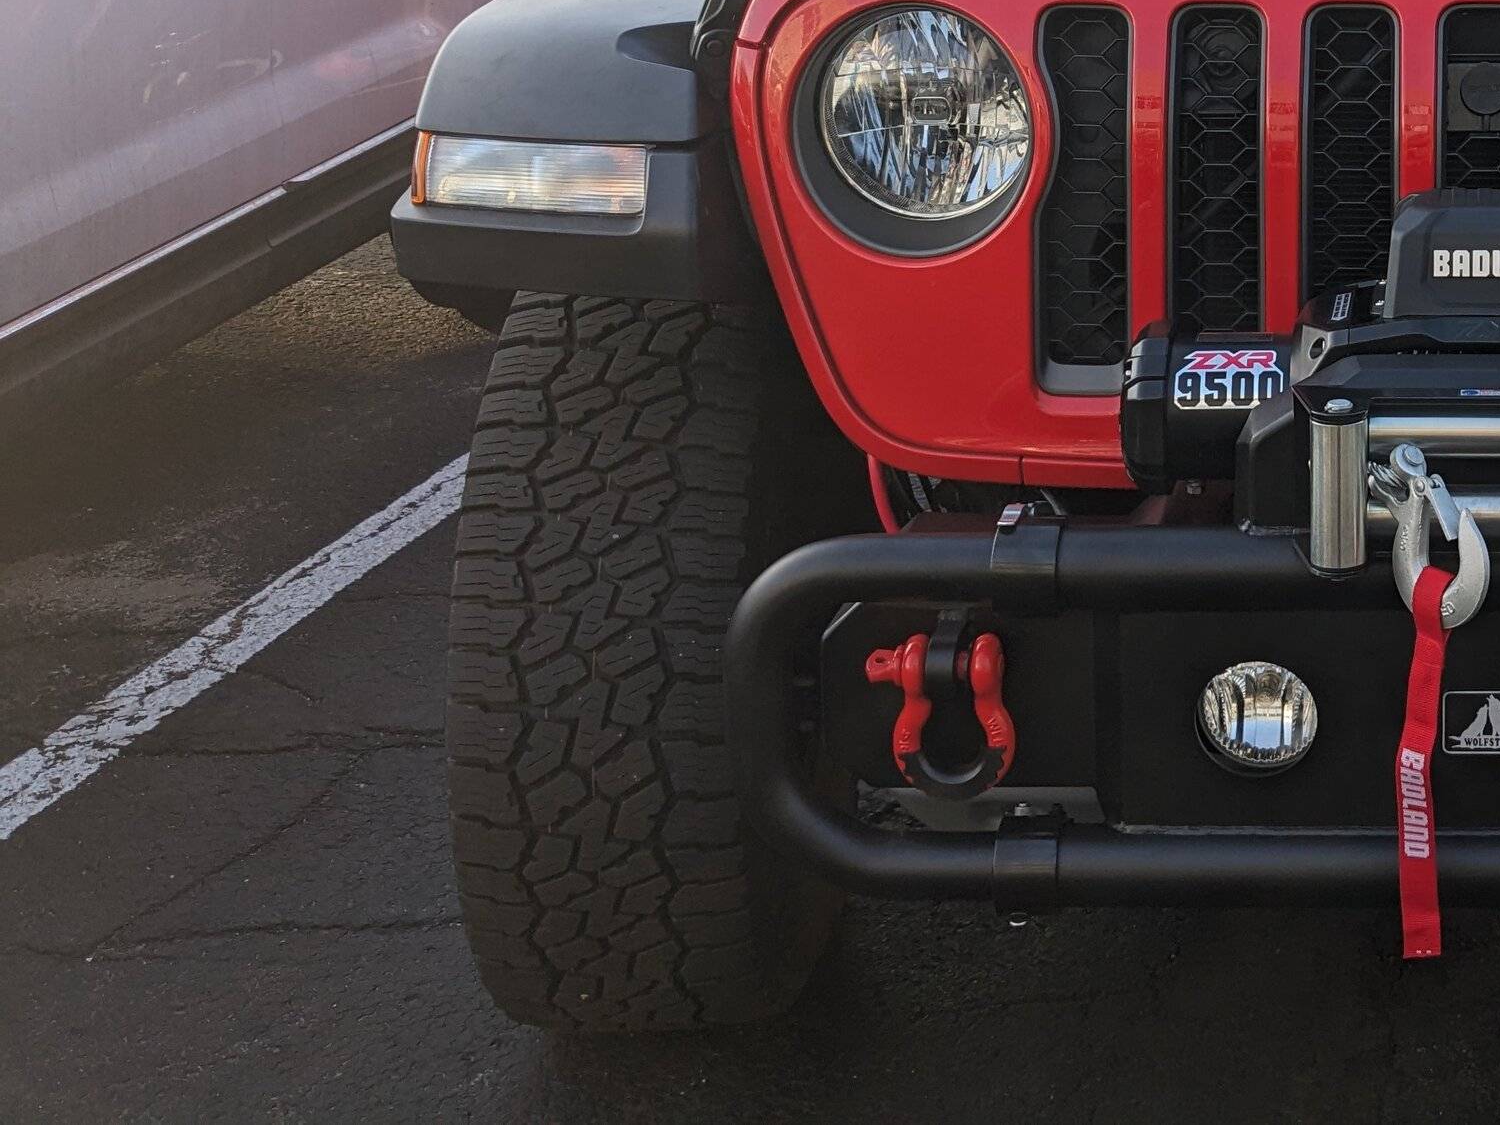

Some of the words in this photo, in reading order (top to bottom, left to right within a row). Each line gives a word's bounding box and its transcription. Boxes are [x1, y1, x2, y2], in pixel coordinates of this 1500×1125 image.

[1187, 352, 1275, 370] ZXR
[1177, 371, 1281, 407] 9500
[1400, 747, 1430, 858] BADLAND
